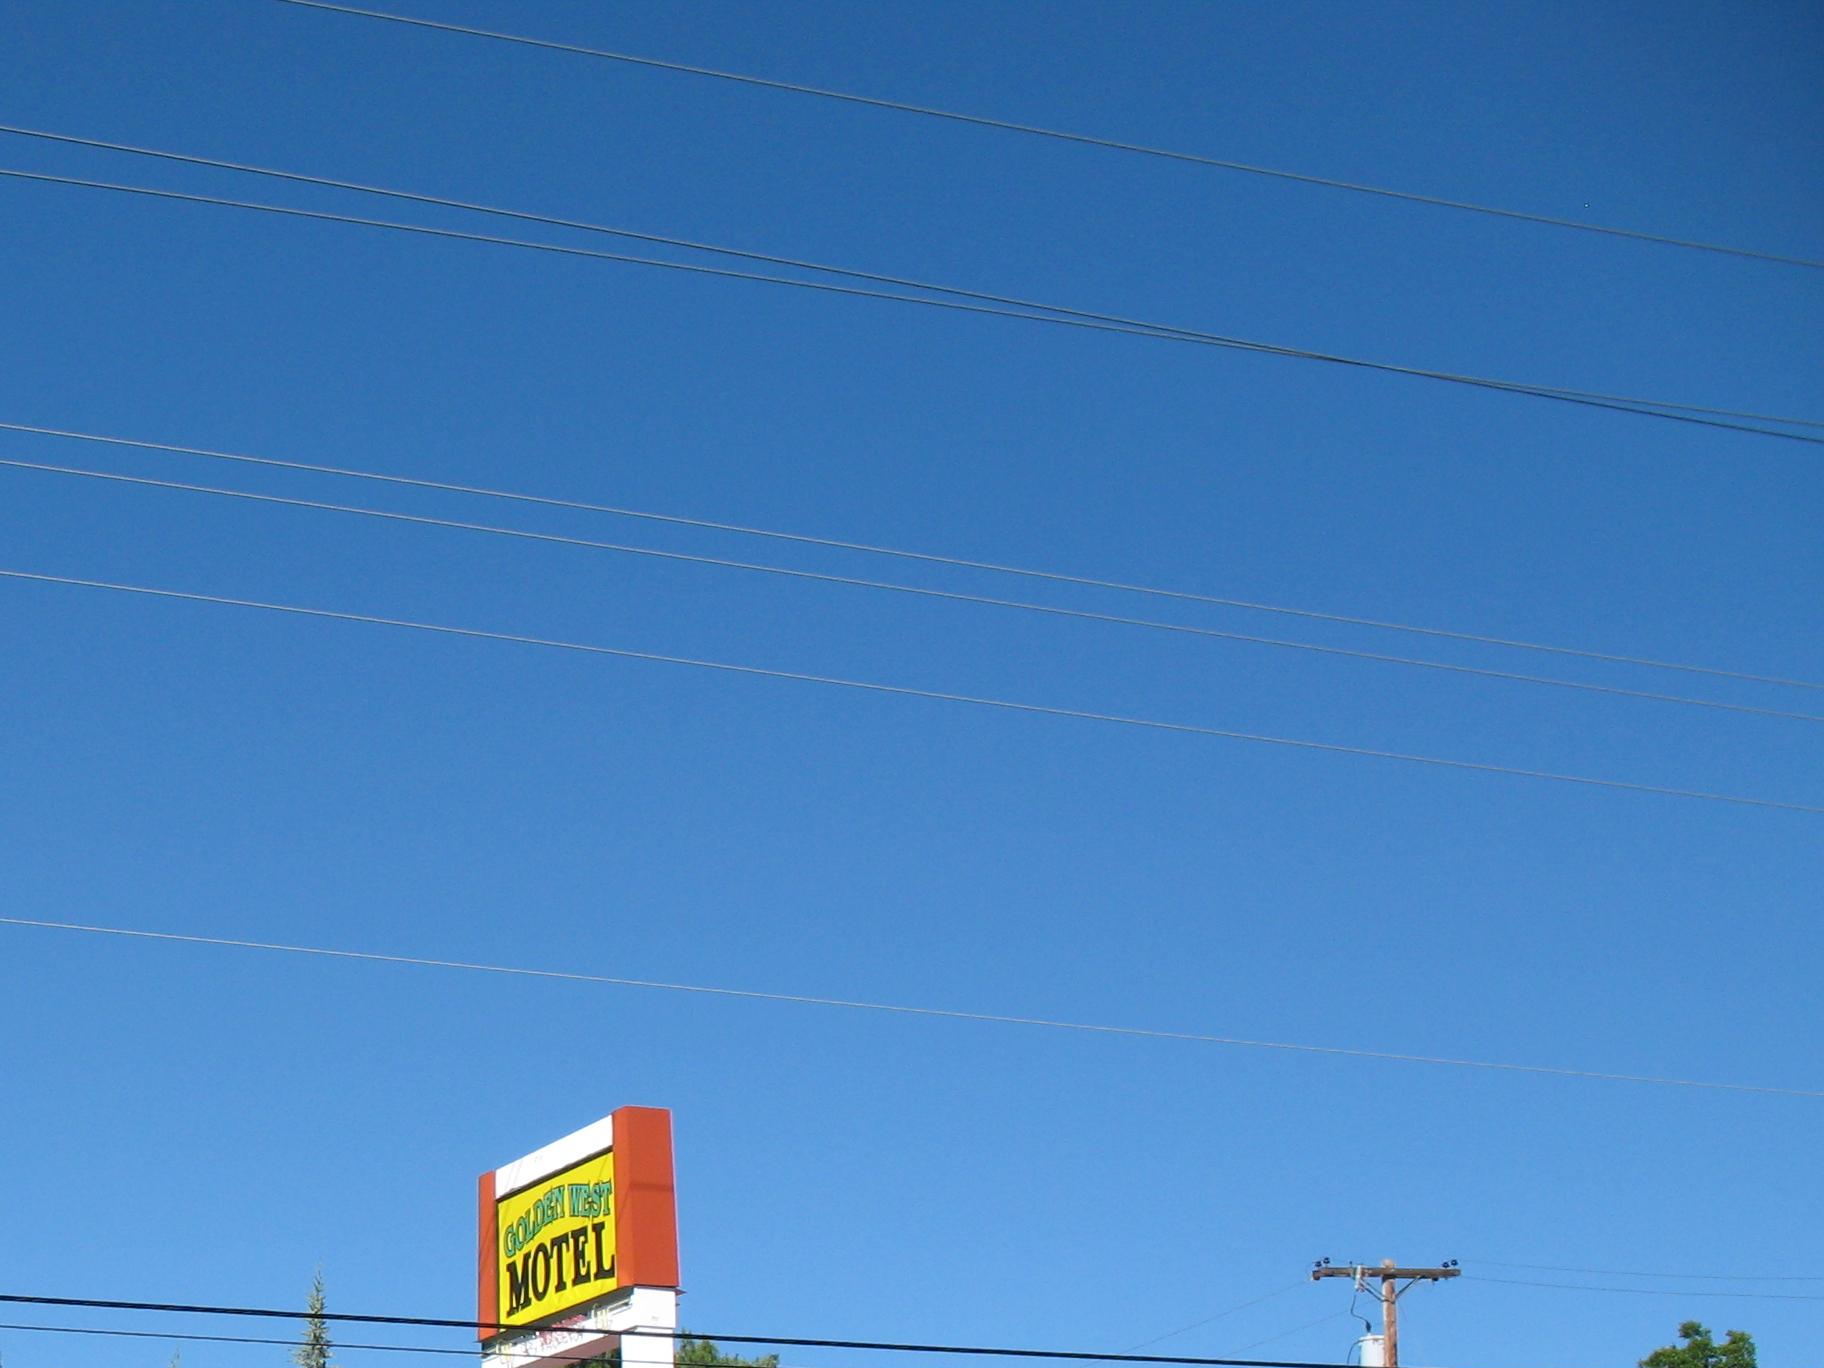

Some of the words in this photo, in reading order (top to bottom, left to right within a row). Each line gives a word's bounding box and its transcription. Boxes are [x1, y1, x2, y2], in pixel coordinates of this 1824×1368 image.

[504, 1184, 565, 1258] GOLDEN
[567, 1178, 613, 1220] WEST
[505, 1221, 616, 1319] MOTEL
